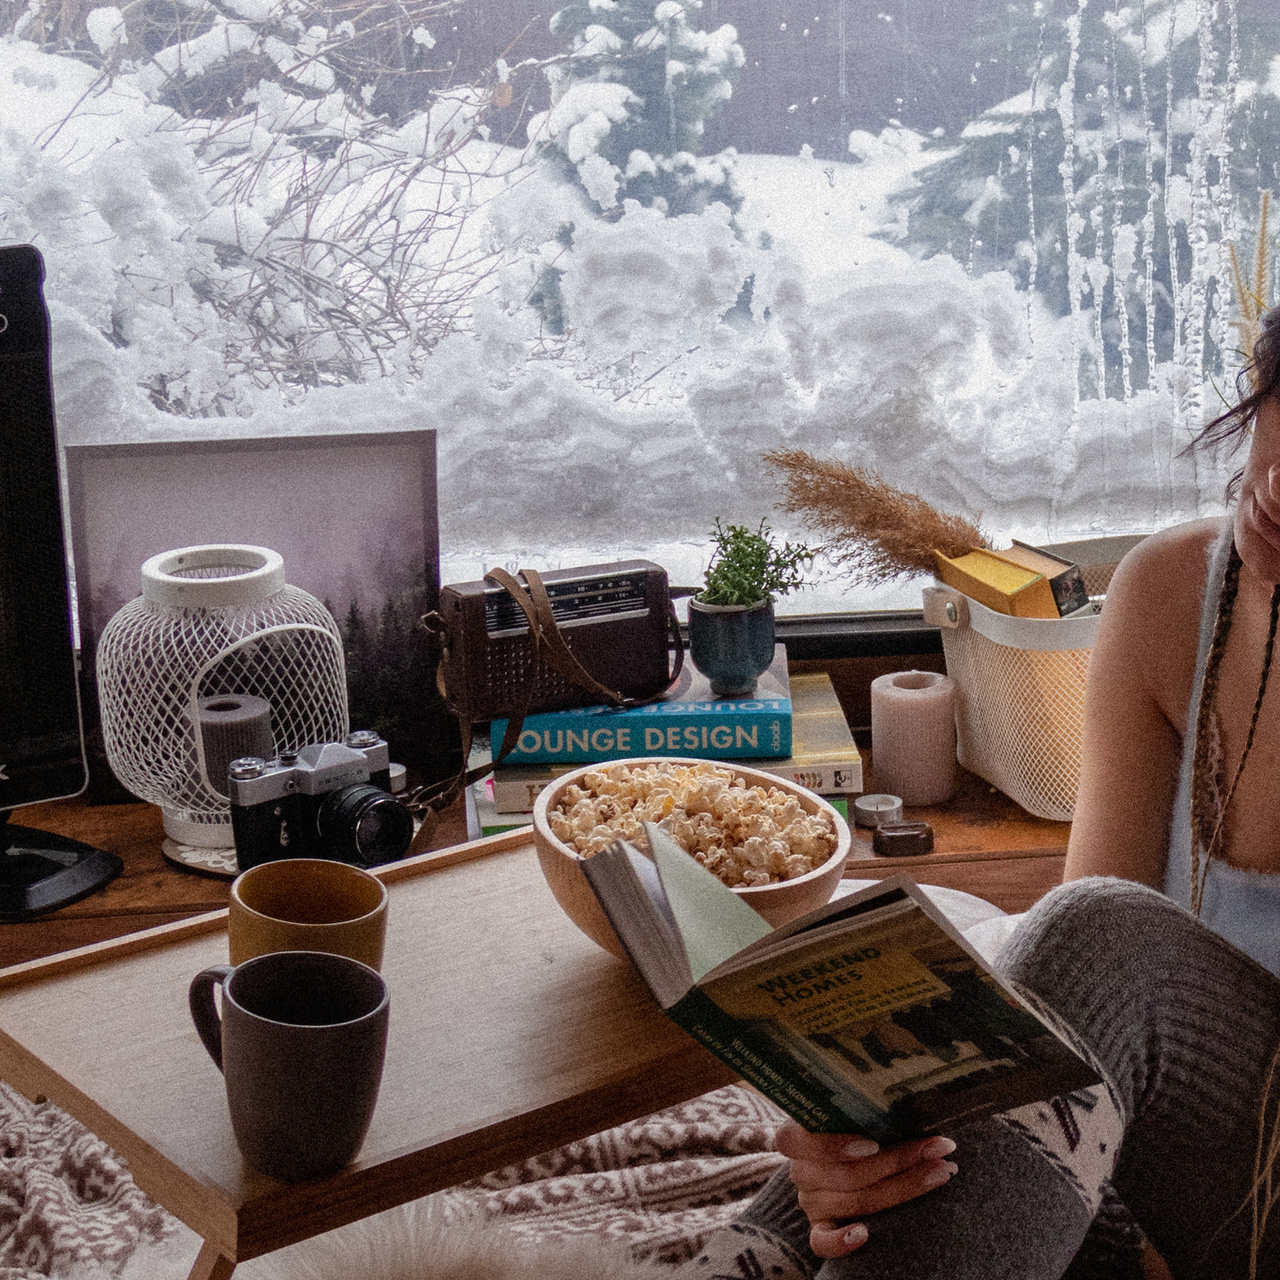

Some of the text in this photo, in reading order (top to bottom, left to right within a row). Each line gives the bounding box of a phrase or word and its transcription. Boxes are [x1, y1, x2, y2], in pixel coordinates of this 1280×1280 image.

[643, 701, 779, 713] LOUNGE
[511, 725, 758, 754] OUNGE DESIGN
[757, 948, 881, 992] WEEKEND
[772, 970, 863, 1007] HOMES
